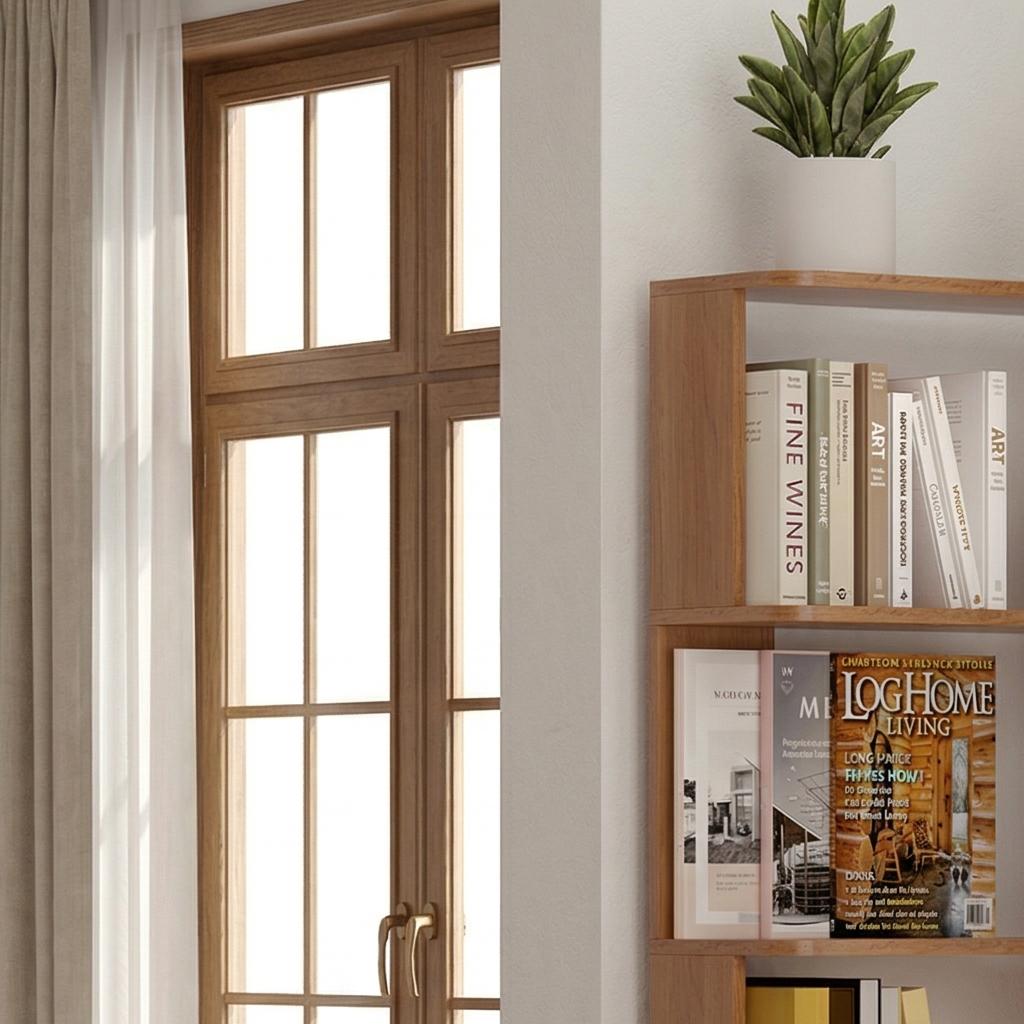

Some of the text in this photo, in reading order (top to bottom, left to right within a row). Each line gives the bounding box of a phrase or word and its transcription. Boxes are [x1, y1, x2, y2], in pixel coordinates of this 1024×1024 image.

[871, 422, 886, 460] ART
[991, 426, 1006, 465] ART
[786, 403, 804, 574] FINE WINES
[886, 717, 951, 737] LIVING
[844, 752, 875, 765] LONG
